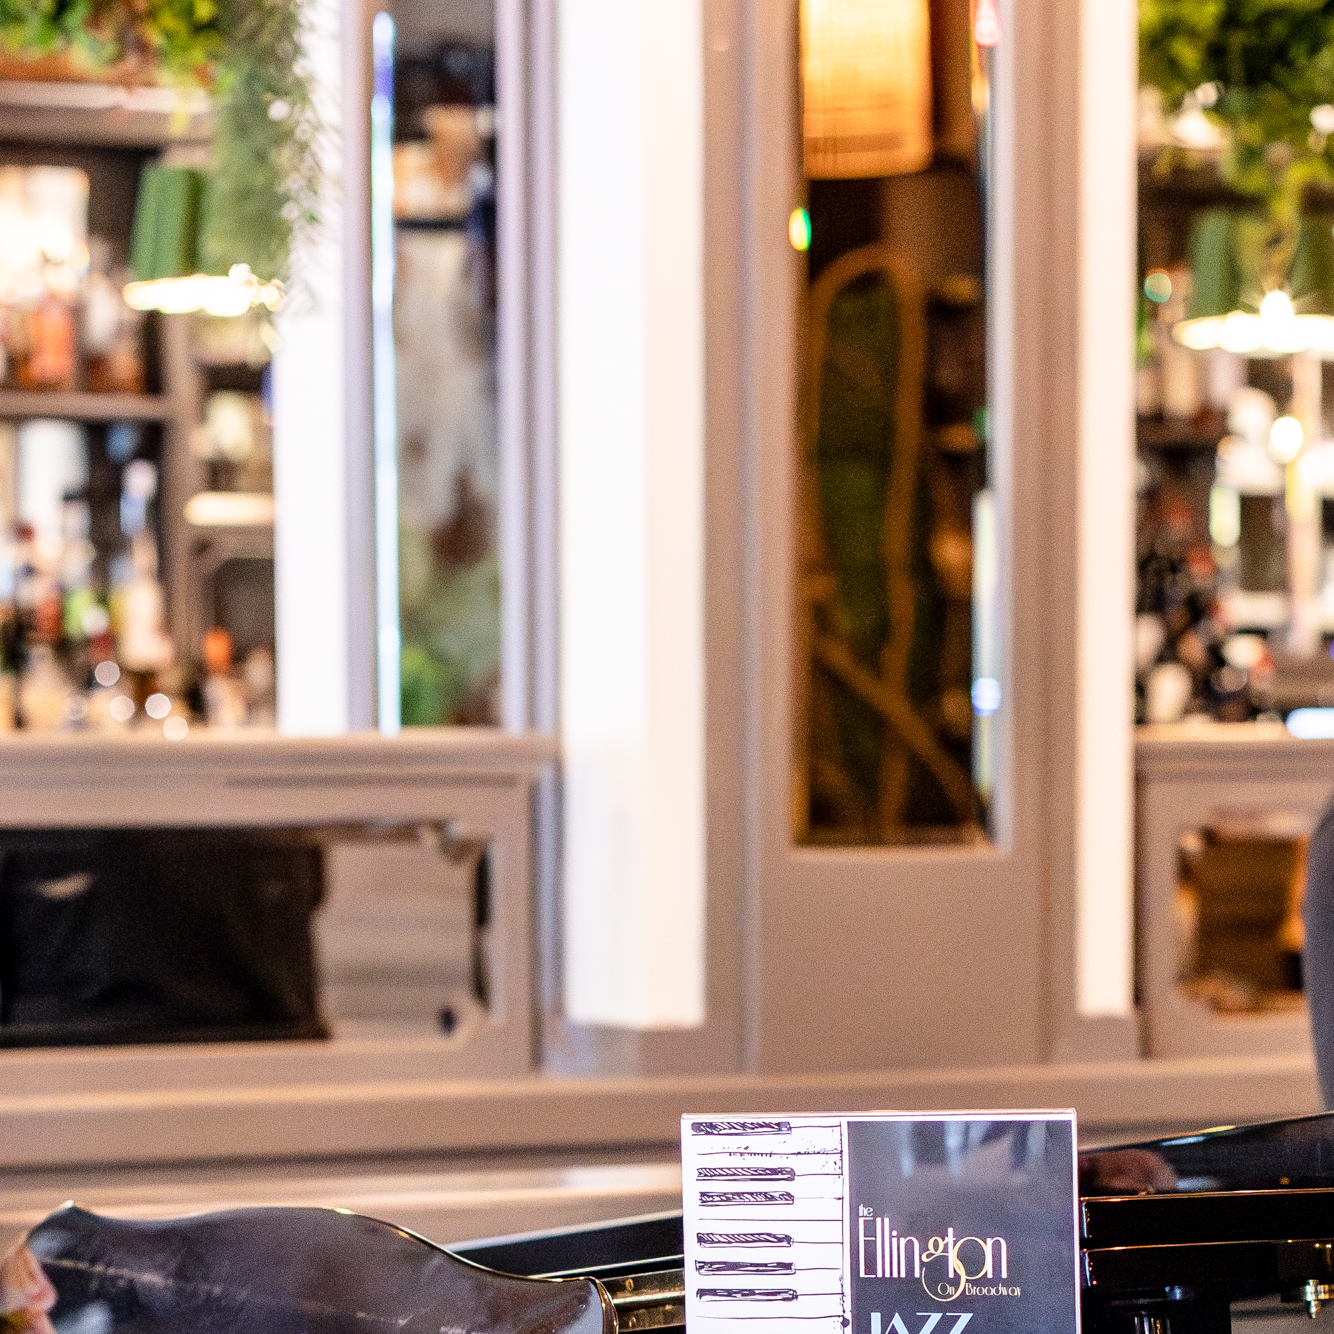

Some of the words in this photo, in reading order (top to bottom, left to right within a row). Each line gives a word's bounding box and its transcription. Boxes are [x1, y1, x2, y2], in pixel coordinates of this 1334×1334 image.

[858, 1203, 874, 1217] the
[858, 1216, 1008, 1302] Ellington
[937, 1282, 955, 1296] On
[965, 1283, 1021, 1298] Broadway
